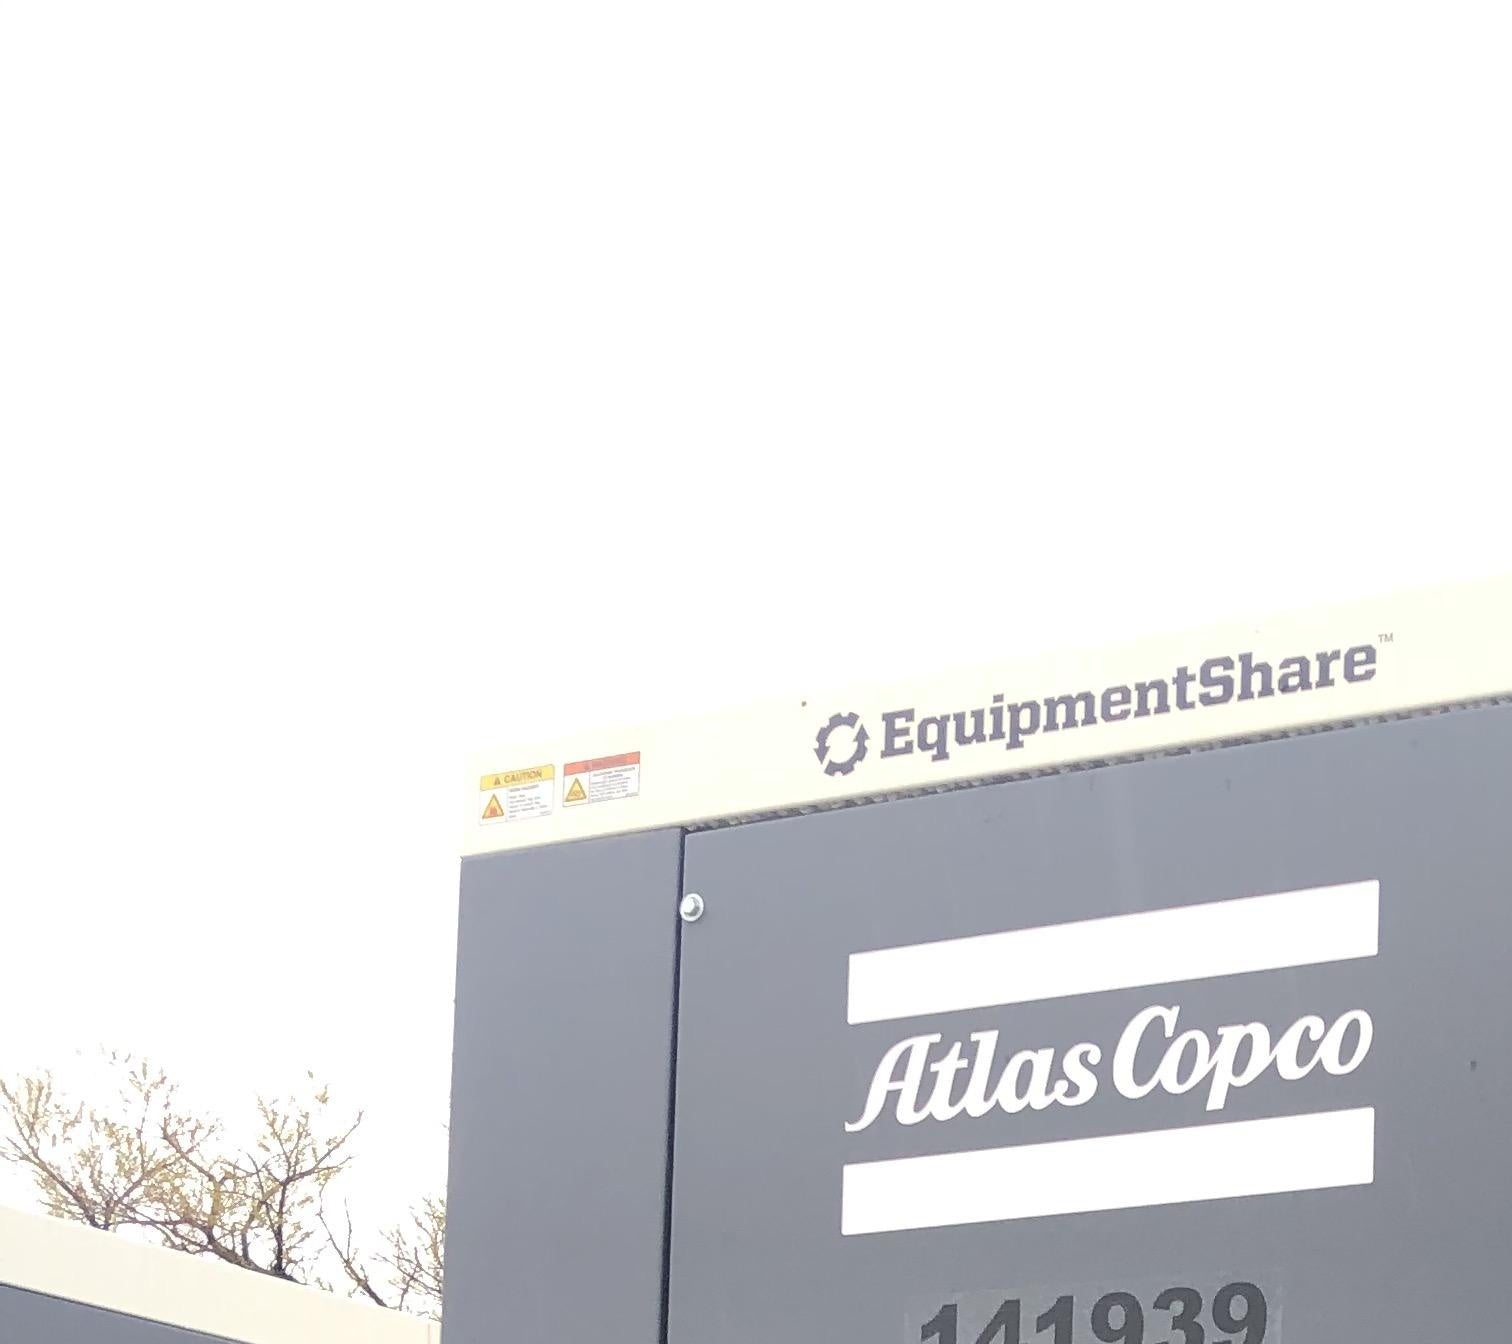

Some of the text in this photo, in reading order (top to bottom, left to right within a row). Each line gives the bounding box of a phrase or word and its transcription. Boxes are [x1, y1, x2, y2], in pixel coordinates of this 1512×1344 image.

[880, 643, 1378, 762] EquipmentShare
[504, 769, 542, 784] CAUTION
[844, 1004, 1374, 1132] Atlas Copco
